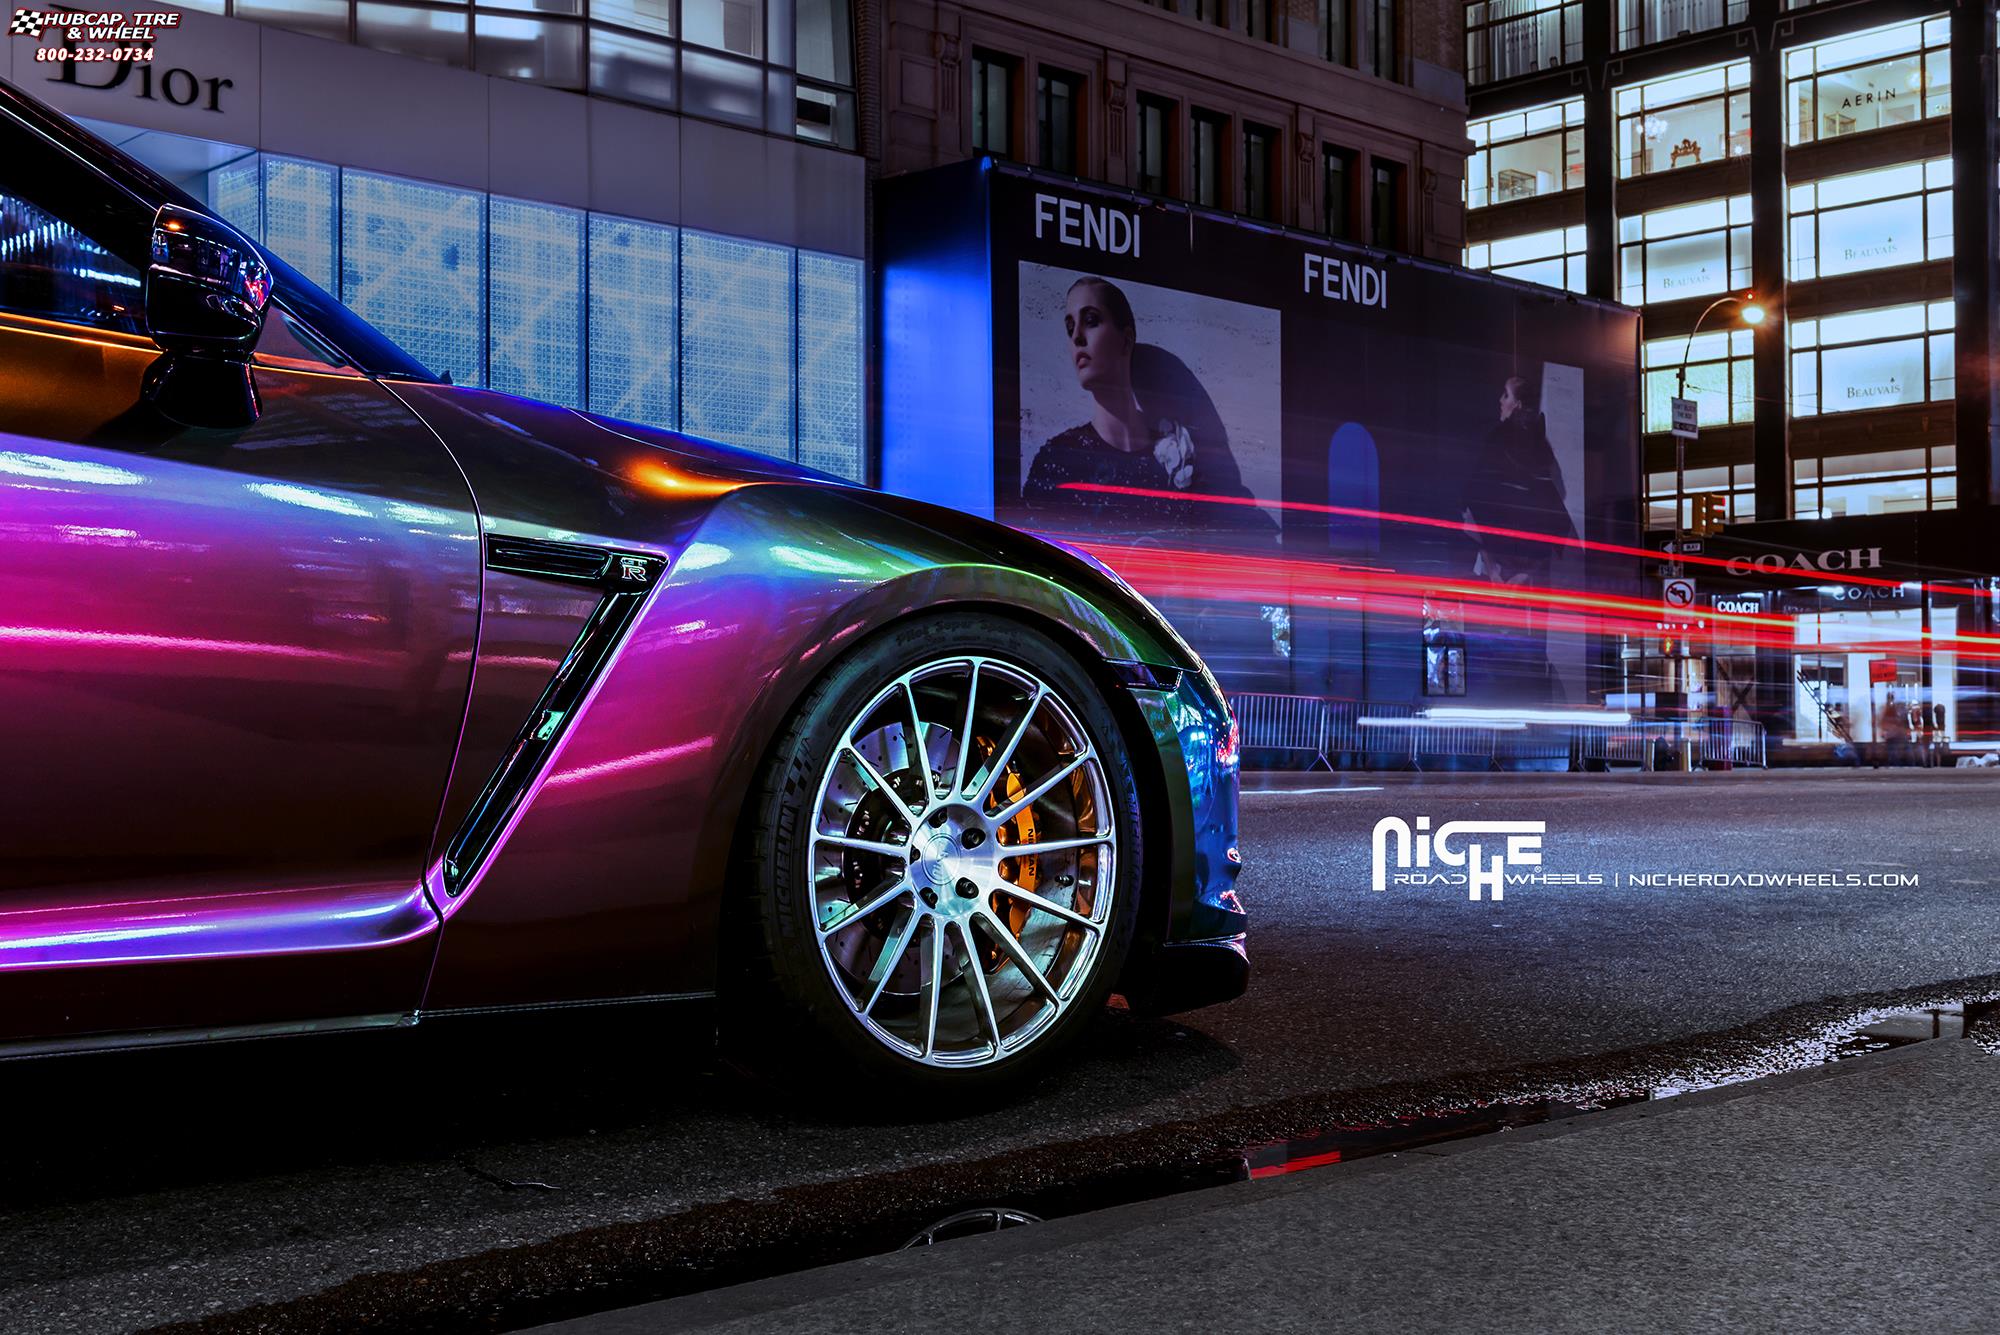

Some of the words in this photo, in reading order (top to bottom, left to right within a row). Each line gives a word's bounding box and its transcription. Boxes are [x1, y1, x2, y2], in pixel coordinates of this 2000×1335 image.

[46, 4, 234, 113] Dior
[1842, 88, 1896, 109] AERIN
[1035, 193, 1140, 258] FENDI
[1304, 253, 1387, 309] FENDI
[1726, 548, 1882, 576] COACH
[1717, 600, 1760, 614] COACH
[1833, 586, 1905, 601] COACH
[776, 804, 798, 939] MICHELIN
